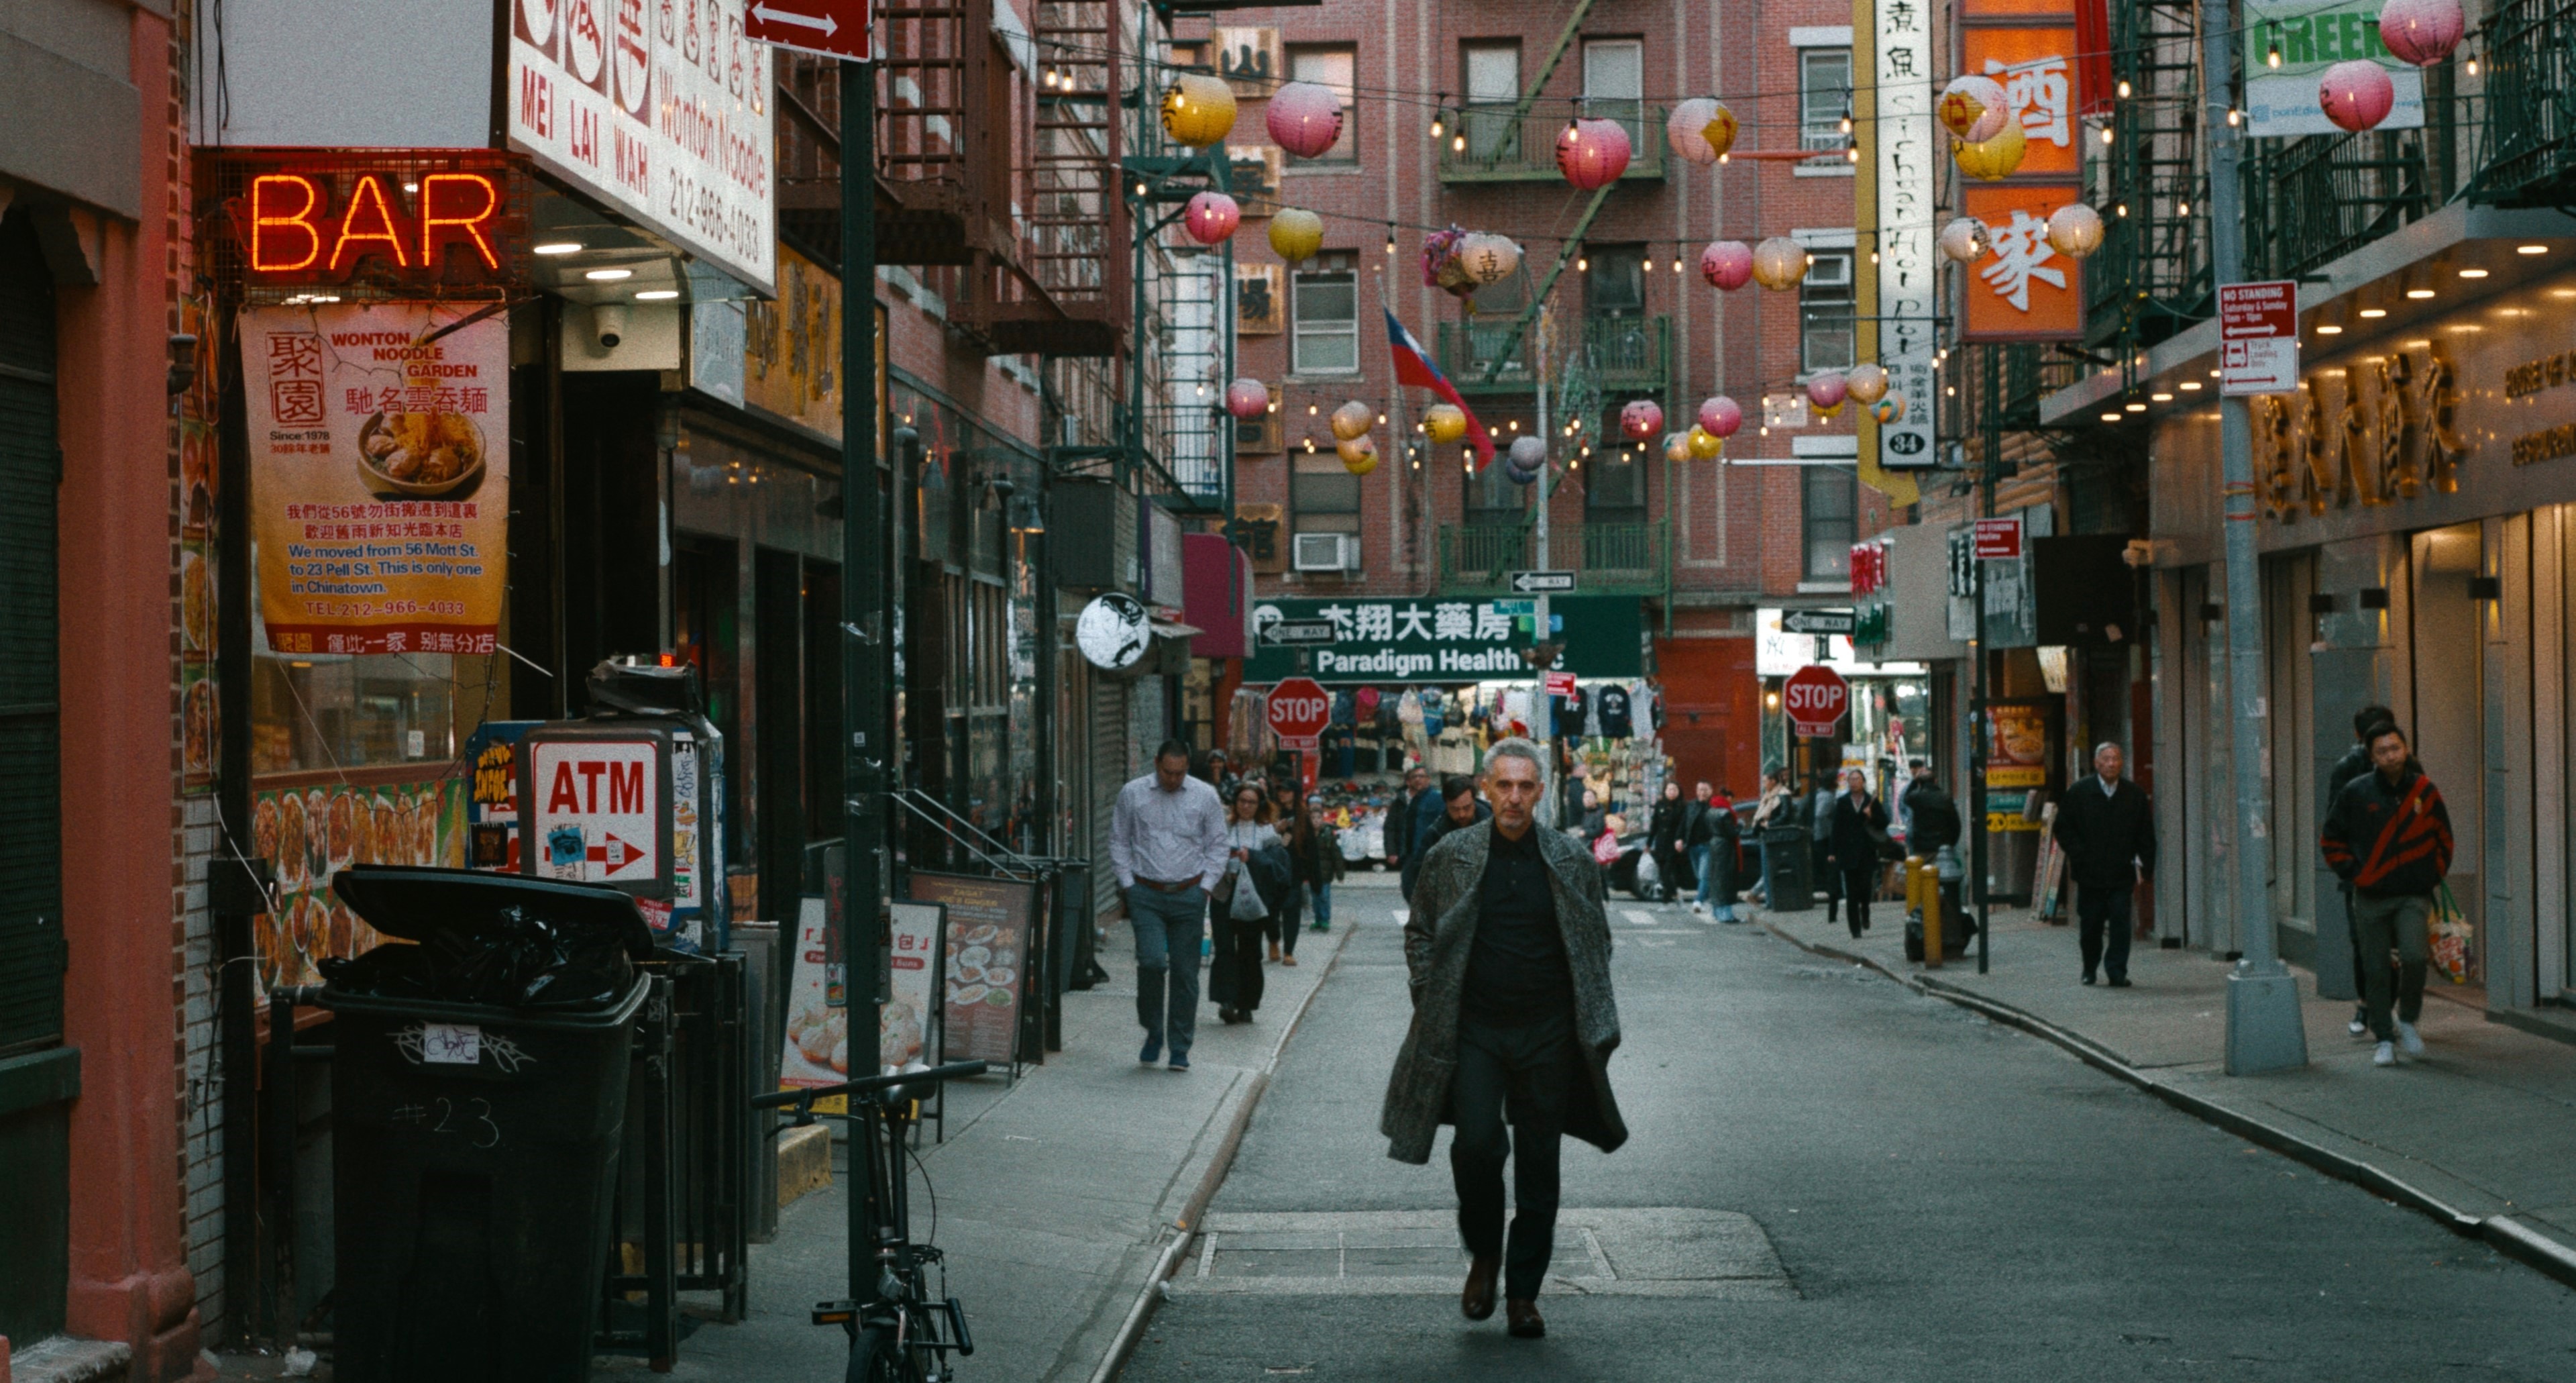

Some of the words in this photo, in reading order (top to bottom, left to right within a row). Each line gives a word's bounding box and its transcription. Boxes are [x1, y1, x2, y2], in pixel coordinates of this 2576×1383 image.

[521, 64, 553, 140] MEI
[571, 99, 598, 167] LAI
[614, 123, 648, 197] WAH
[659, 66, 714, 166] Wonton
[719, 109, 765, 199] Noodle
[252, 174, 497, 270] BAR
[671, 167, 758, 263] 212-966-4033
[2223, 290, 2236, 301] NO
[2239, 287, 2284, 299] STANDING
[331, 332, 410, 346] WONTON
[373, 348, 443, 360] NOODLE
[407, 364, 478, 377] GARDEN
[270, 336, 323, 423] 聚園
[1894, 435, 1917, 452] 34
[288, 545, 311, 558] We
[315, 545, 363, 558] moved
[366, 544, 401, 557] from
[405, 543, 423, 556] 56
[426, 543, 456, 556] Mott
[460, 544, 478, 557] St.
[290, 564, 303, 576] to
[307, 563, 323, 576] 23
[327, 562, 350, 576] Pell
[354, 562, 373, 576] St.
[378, 561, 408, 574] This
[412, 560, 423, 574] is
[427, 562, 452, 577] only
[456, 565, 482, 575] one
[292, 581, 303, 593] in
[307, 581, 386, 594] Chinatown.
[1548, 578, 1566, 586] WAY
[307, 601, 464, 616] TEL:212-966-4033
[1319, 604, 1512, 641] 杰翔大藥房
[1792, 617, 1811, 627] ONE
[1824, 618, 1847, 628] WAY
[1271, 628, 1292, 637] ONE
[1303, 627, 1326, 637] WAY
[1318, 649, 1433, 677] Paradigm
[1440, 648, 1520, 671] Health
[1788, 683, 1843, 709] STOP
[1271, 697, 1326, 722] STOP
[1798, 725, 1812, 733] ALL
[1815, 725, 1832, 733] WAY
[548, 761, 645, 814] ATM
